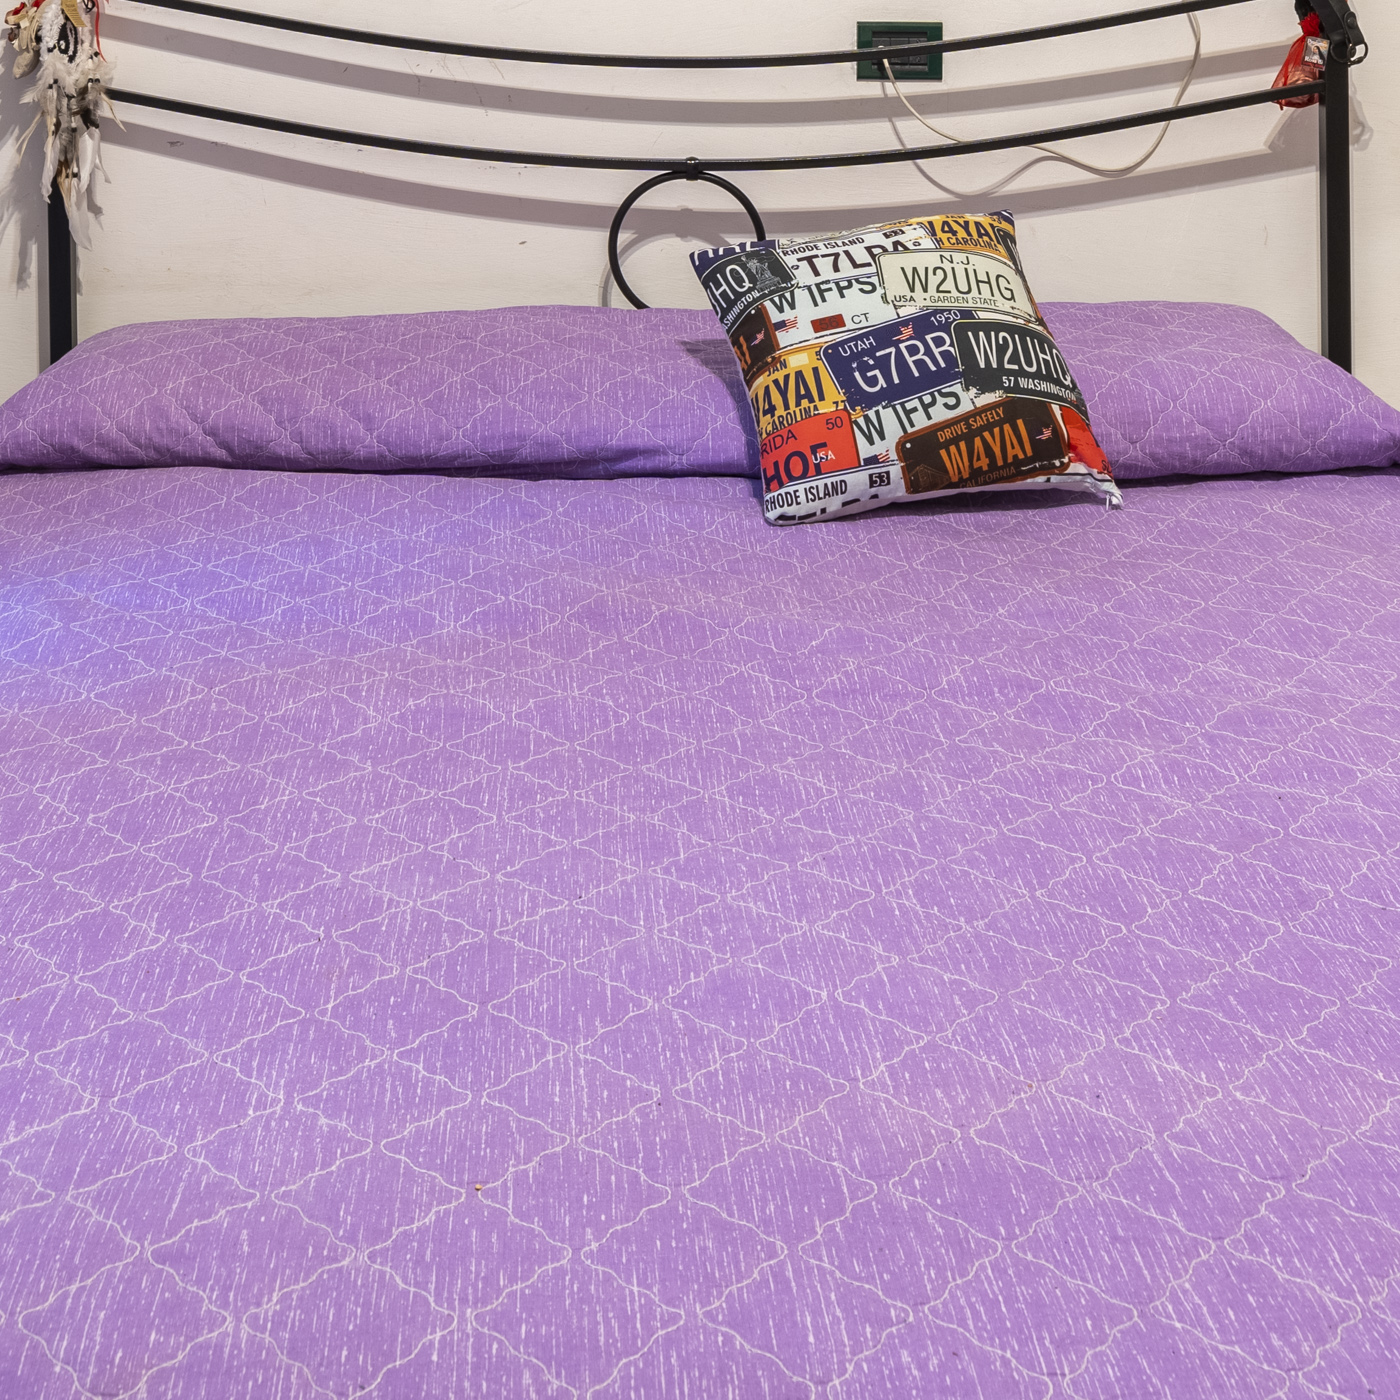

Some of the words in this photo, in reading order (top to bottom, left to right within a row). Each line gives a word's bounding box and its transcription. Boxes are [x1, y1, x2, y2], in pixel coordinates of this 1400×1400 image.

[782, 242, 822, 256] RHODE
[823, 236, 866, 250] ISLAND
[940, 254, 975, 266] N.J.
[900, 266, 1016, 302] W2UHG
[894, 295, 916, 303] USA
[930, 296, 969, 304] GARDEN
[971, 297, 998, 307] STATE
[818, 316, 839, 330] 56
[851, 312, 870, 325] CT
[930, 310, 961, 326] 1950
[838, 336, 876, 357] UTAH
[766, 359, 787, 377] JAN
[852, 330, 956, 393] G7RR
[968, 331, 1073, 388] W2UHQ
[1002, 376, 1014, 387] 57
[1018, 378, 1077, 404] WASHINGTON
[825, 416, 844, 430] 50
[937, 420, 968, 443] DRIVE
[971, 407, 1005, 429] SAFELY
[812, 450, 835, 464] USA
[940, 419, 1033, 482] W4YAI
[872, 474, 888, 487] 53
[959, 466, 1016, 489] CALIFORNIA
[765, 488, 801, 514] RHODE
[805, 479, 848, 504] ISLAND
